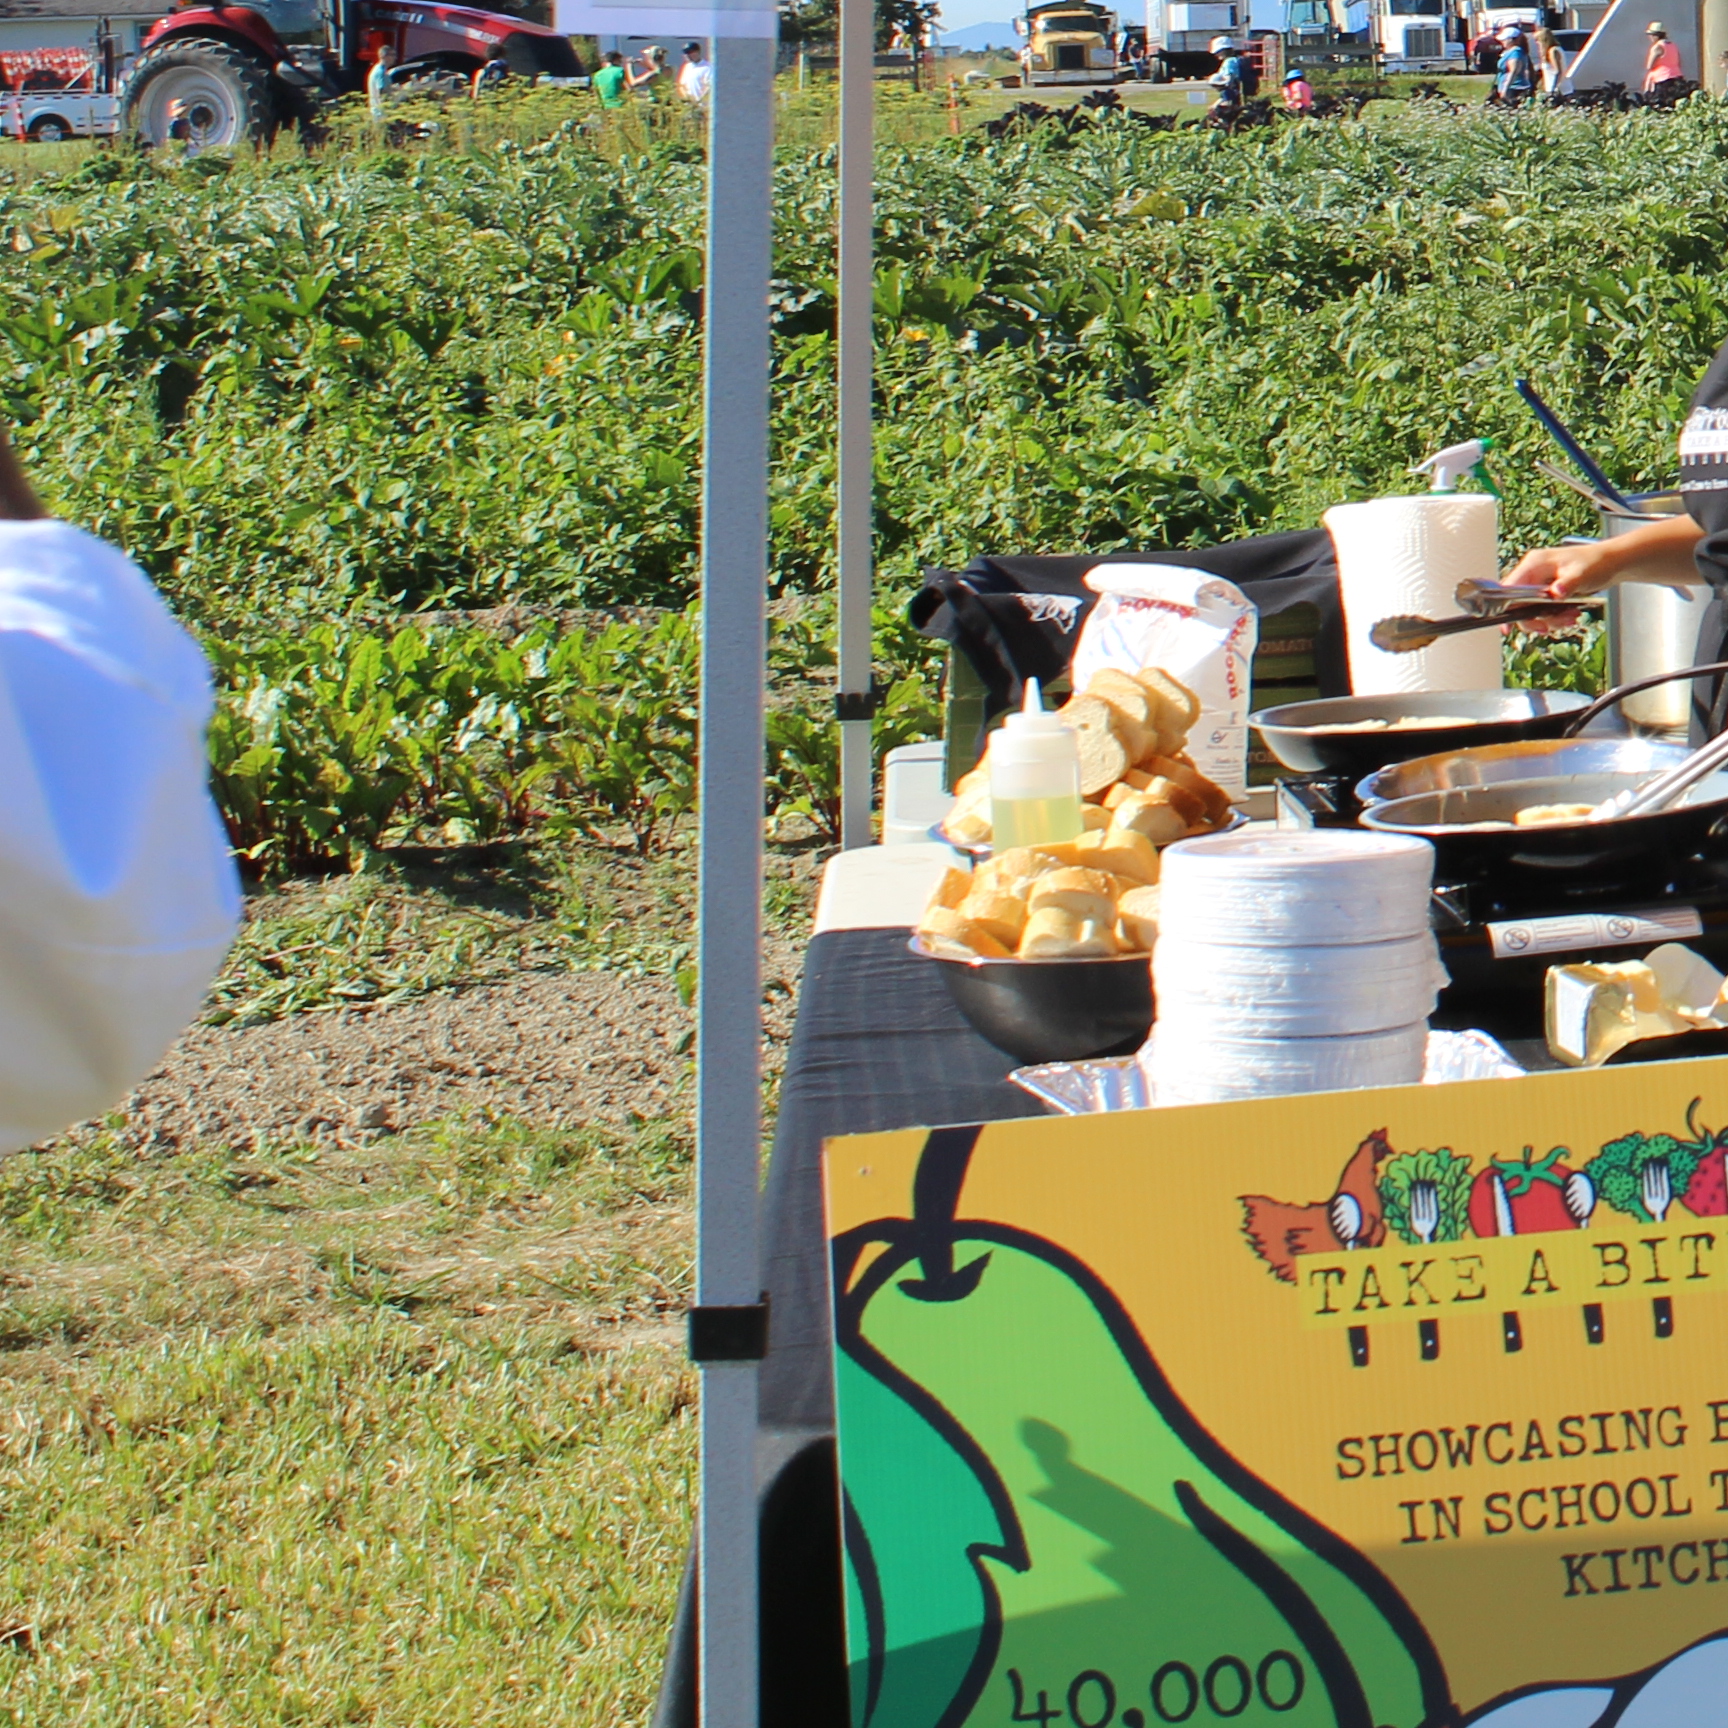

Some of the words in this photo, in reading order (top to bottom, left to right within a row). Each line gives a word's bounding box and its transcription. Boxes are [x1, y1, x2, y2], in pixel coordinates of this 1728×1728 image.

[1310, 1253, 1487, 1317] TAKE
[1523, 1248, 1561, 1297] A
[1335, 1405, 1689, 1481] SHOWCASING
[1399, 1495, 1463, 1545] IN
[1484, 1473, 1694, 1537] SCHOOL
[1005, 1649, 1306, 1728] 40,000
